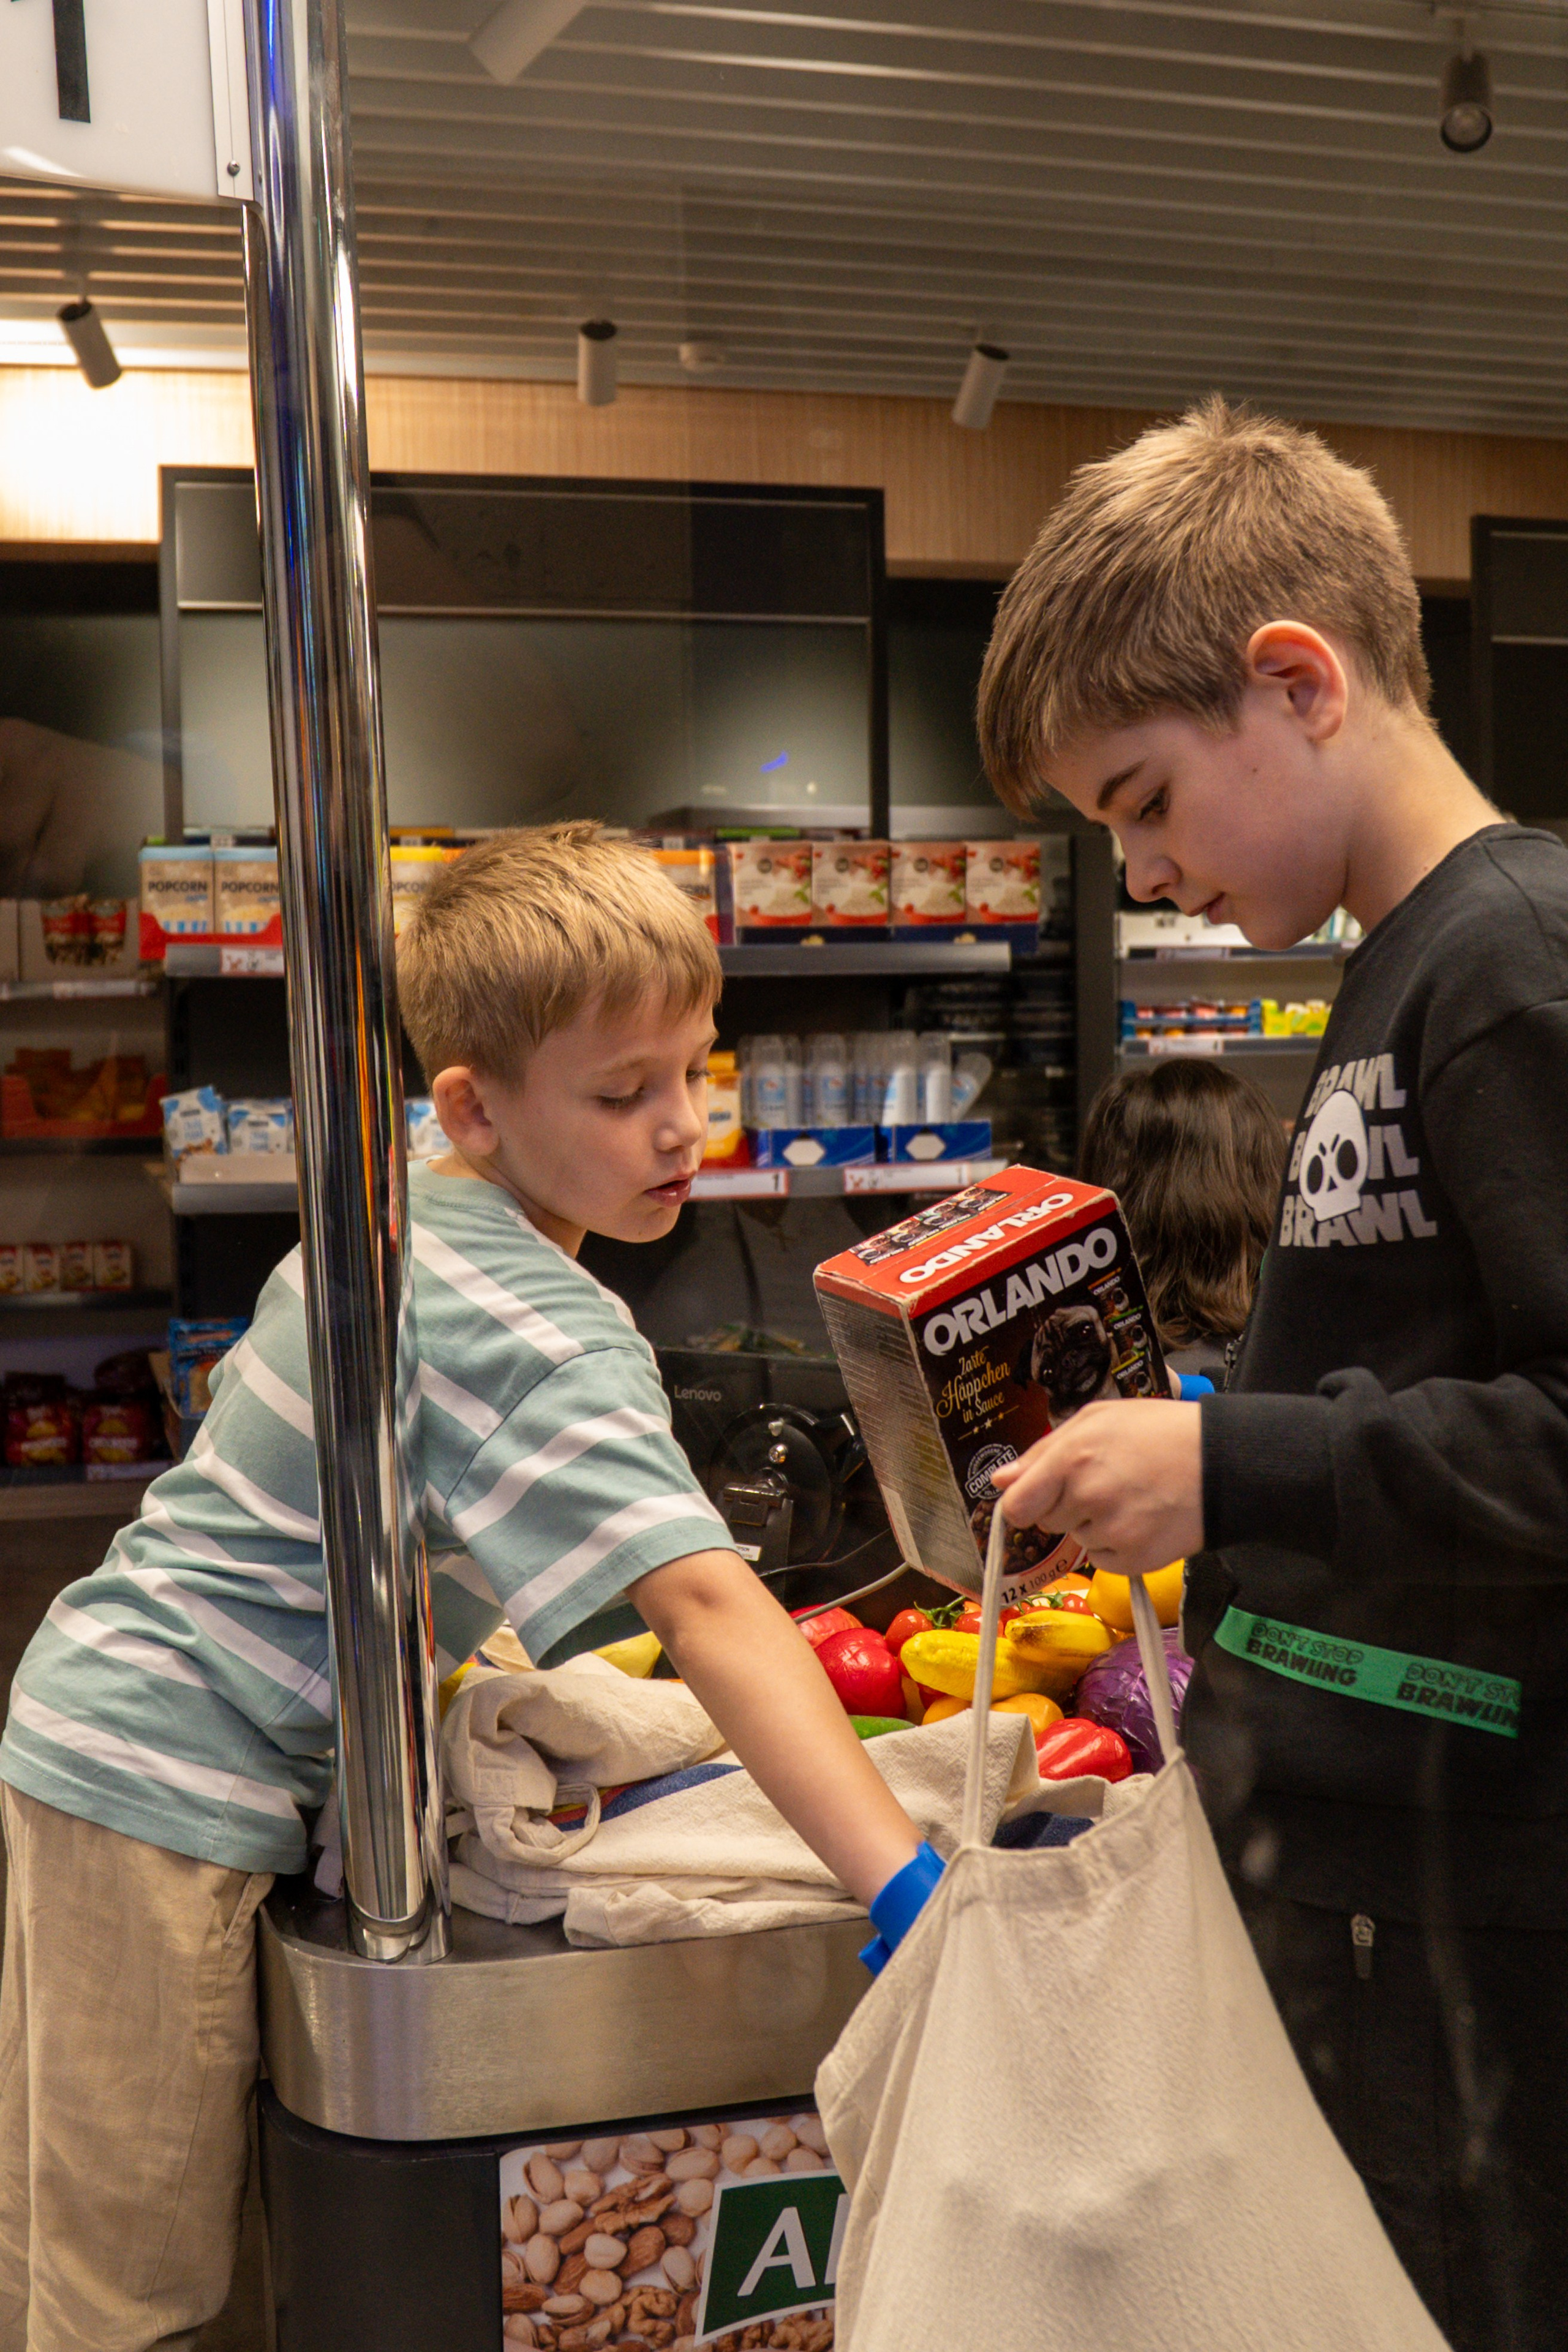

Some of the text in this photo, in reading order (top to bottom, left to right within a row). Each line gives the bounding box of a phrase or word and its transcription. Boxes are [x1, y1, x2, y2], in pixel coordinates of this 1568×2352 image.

[149, 881, 207, 892] POPCORN
[900, 1193, 1073, 1283] ORLANDO
[924, 1227, 1117, 1356] ORLANDO
[1093, 1276, 1120, 1295] ORLANDO
[1114, 1313, 1142, 1330] ORLANDO
[959, 1345, 990, 1376] Zarte
[1117, 1360, 1144, 1379] ORLANDO
[674, 1385, 722, 1402] Lenovo
[936, 1362, 1010, 1419] Häppchen
[962, 1392, 1005, 1423] in Sauce
[1001, 1587, 1017, 1604] 12
[1019, 1583, 1027, 1595] x
[1029, 1574, 1047, 1589] 100
[1311, 1640, 1364, 1665] STOP
